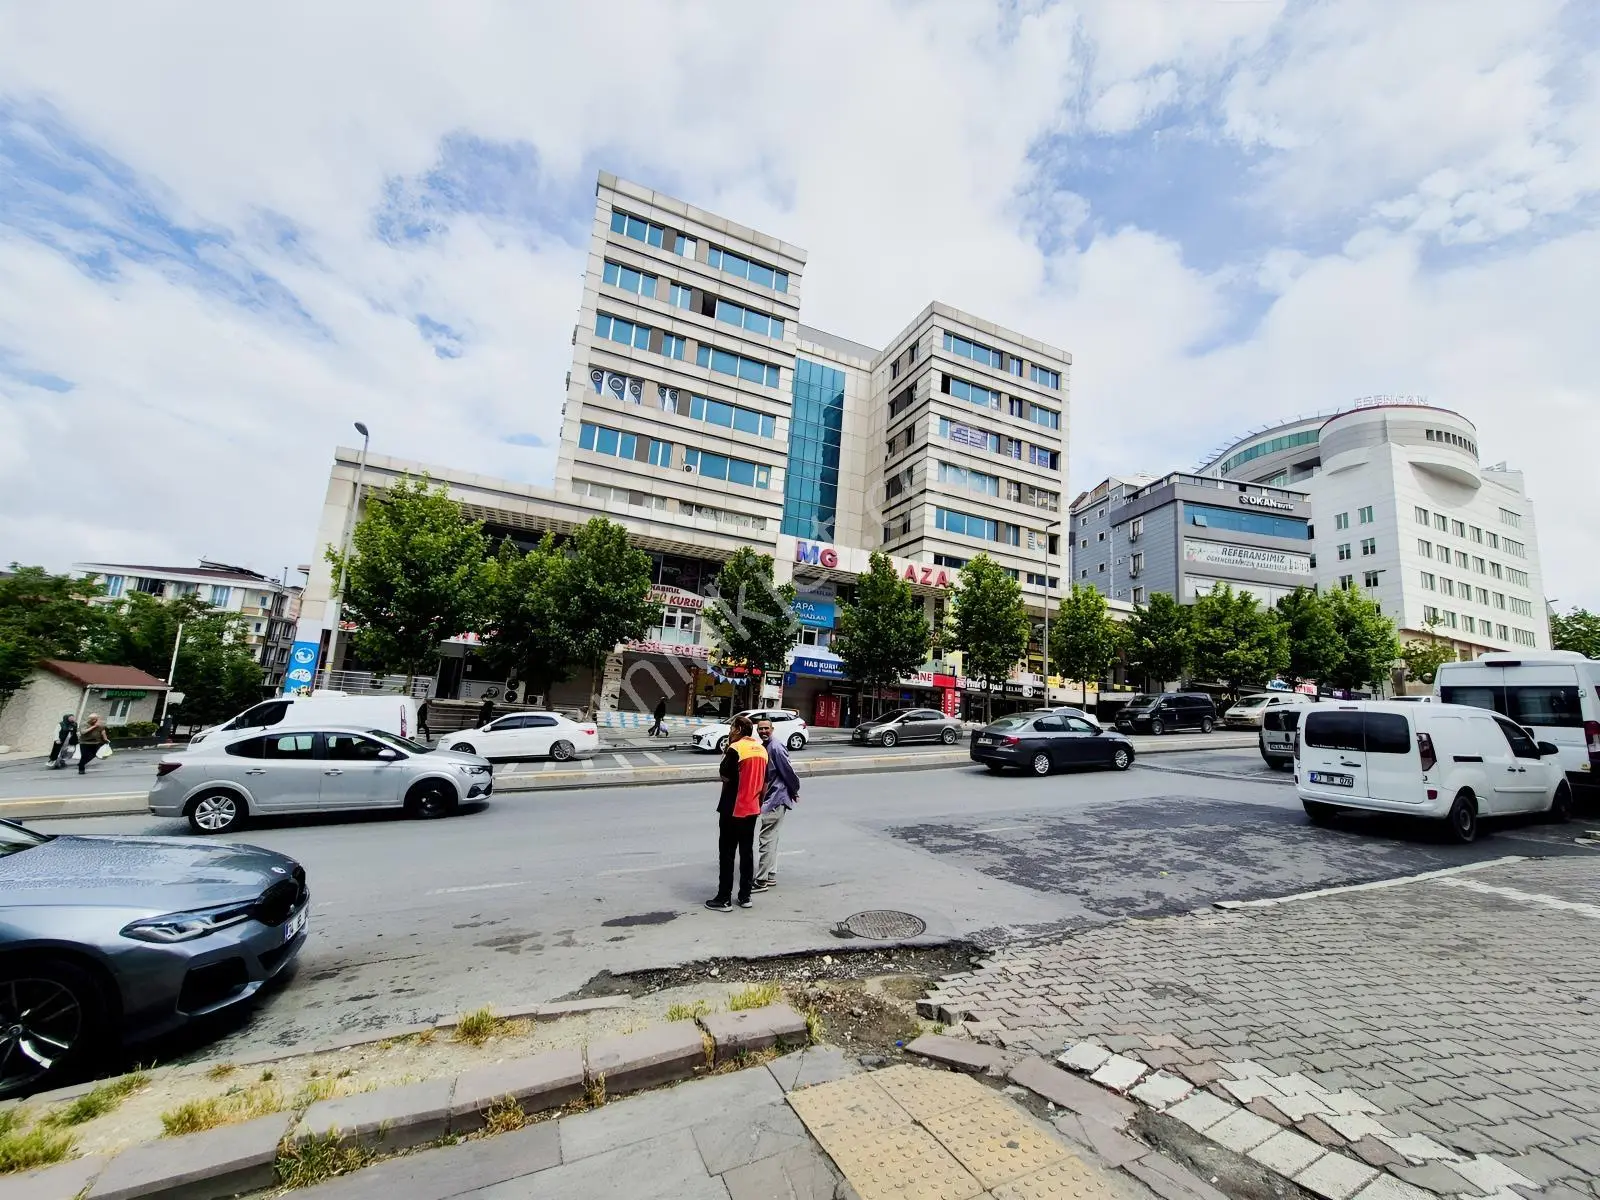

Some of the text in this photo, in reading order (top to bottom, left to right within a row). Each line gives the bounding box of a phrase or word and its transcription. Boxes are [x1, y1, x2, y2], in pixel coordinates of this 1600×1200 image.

[1249, 496, 1277, 508] OKAN
[796, 540, 950, 589] MG AZA
[669, 595, 703, 608] KURSU
[911, 671, 932, 682] ANE
